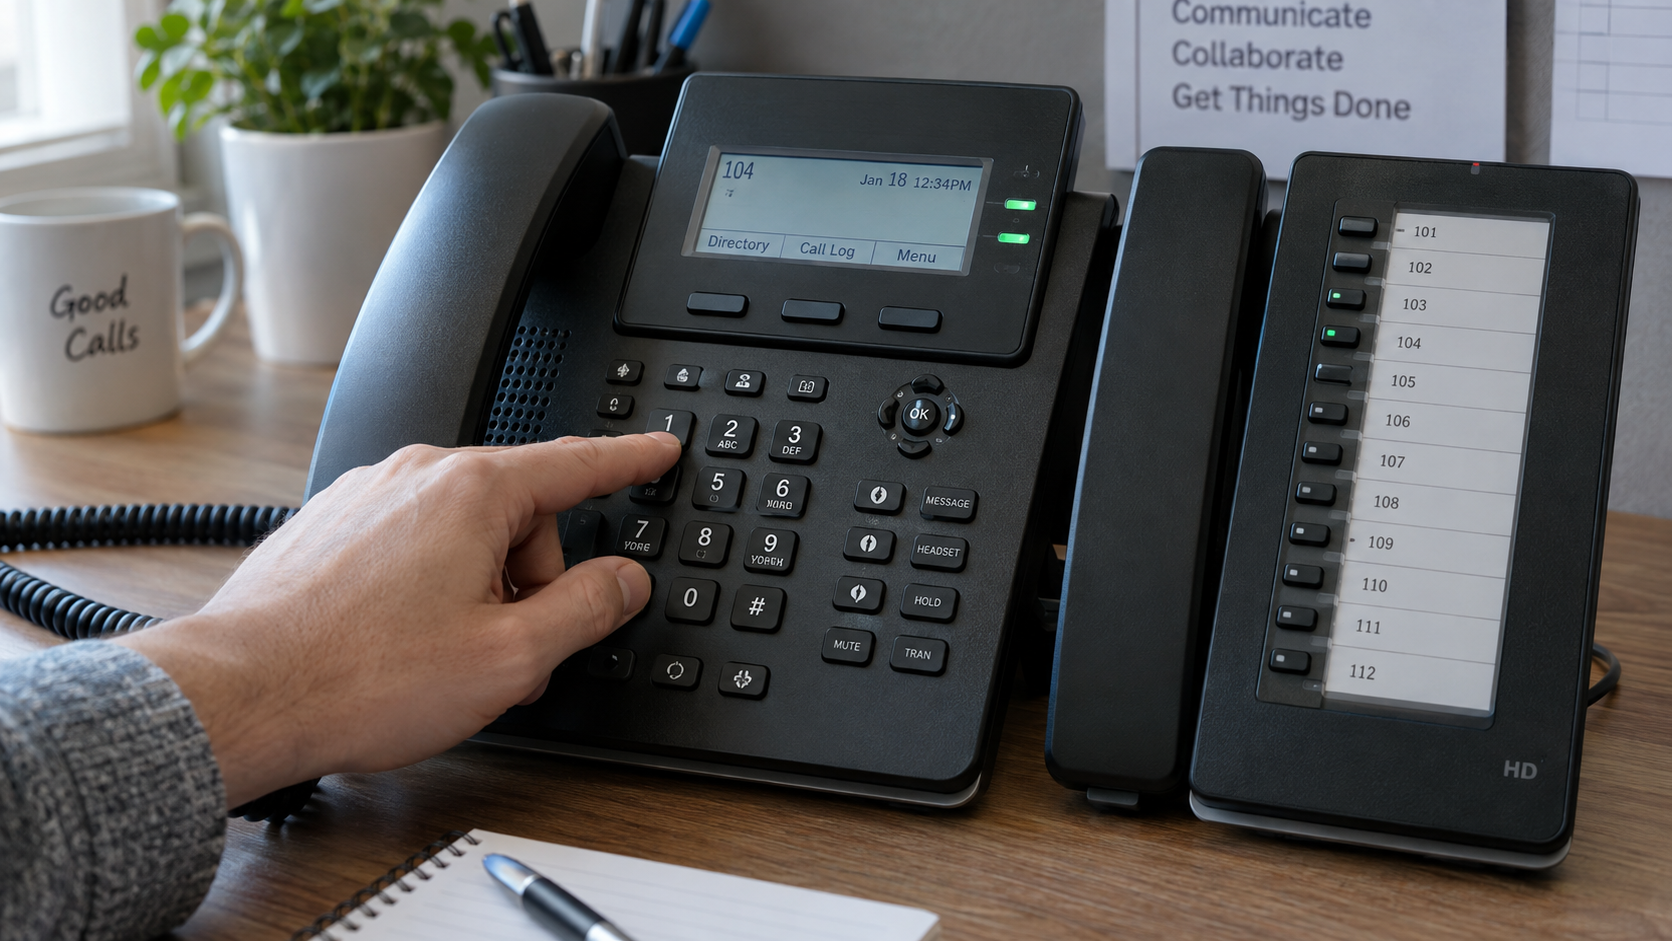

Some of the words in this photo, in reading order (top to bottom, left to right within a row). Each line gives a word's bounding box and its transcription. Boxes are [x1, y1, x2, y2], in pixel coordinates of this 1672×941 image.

[1172, 0, 1371, 29] Communicate
[1172, 40, 1343, 71] Collaborate
[1173, 83, 1221, 111] Get
[1230, 86, 1325, 121] Things
[1334, 91, 1411, 120] Done
[723, 161, 754, 179] 104
[860, 174, 882, 185] Jan
[889, 172, 907, 187] 18
[914, 177, 971, 191] 12:34PM
[1415, 226, 1435, 237] 101
[708, 235, 770, 253] Directory
[801, 242, 826, 255] Call
[830, 244, 855, 259] Log
[897, 249, 936, 263] Menu
[1409, 262, 1432, 274] 102
[50, 273, 129, 322] Good
[1404, 299, 1426, 311] 103
[65, 318, 139, 362] Calls
[1398, 337, 1420, 349] 104
[1392, 375, 1415, 388] 105
[910, 407, 929, 420] OK
[1387, 414, 1410, 427] 106
[664, 414, 674, 431] 1
[724, 420, 737, 437] 2
[789, 426, 801, 443] 3
[717, 440, 738, 450] ABC
[782, 446, 802, 455] DEF
[1381, 455, 1405, 468] 107
[712, 473, 724, 490] 5
[777, 480, 789, 497] 6
[925, 496, 970, 509] MESSAGE
[1375, 495, 1399, 509] 108
[636, 520, 648, 538] 7
[699, 528, 711, 545] 8
[765, 534, 777, 552] 9
[916, 545, 961, 557] HEADSET
[1370, 536, 1393, 550] 109
[1363, 578, 1387, 592] 110
[684, 588, 697, 606] 0
[914, 596, 942, 607] HOLD
[749, 597, 765, 615] #
[1357, 619, 1379, 634] 111
[833, 640, 861, 652] MUTE
[905, 648, 932, 660] TRAN
[1350, 664, 1375, 680] 112
[1504, 760, 1537, 779] HD
